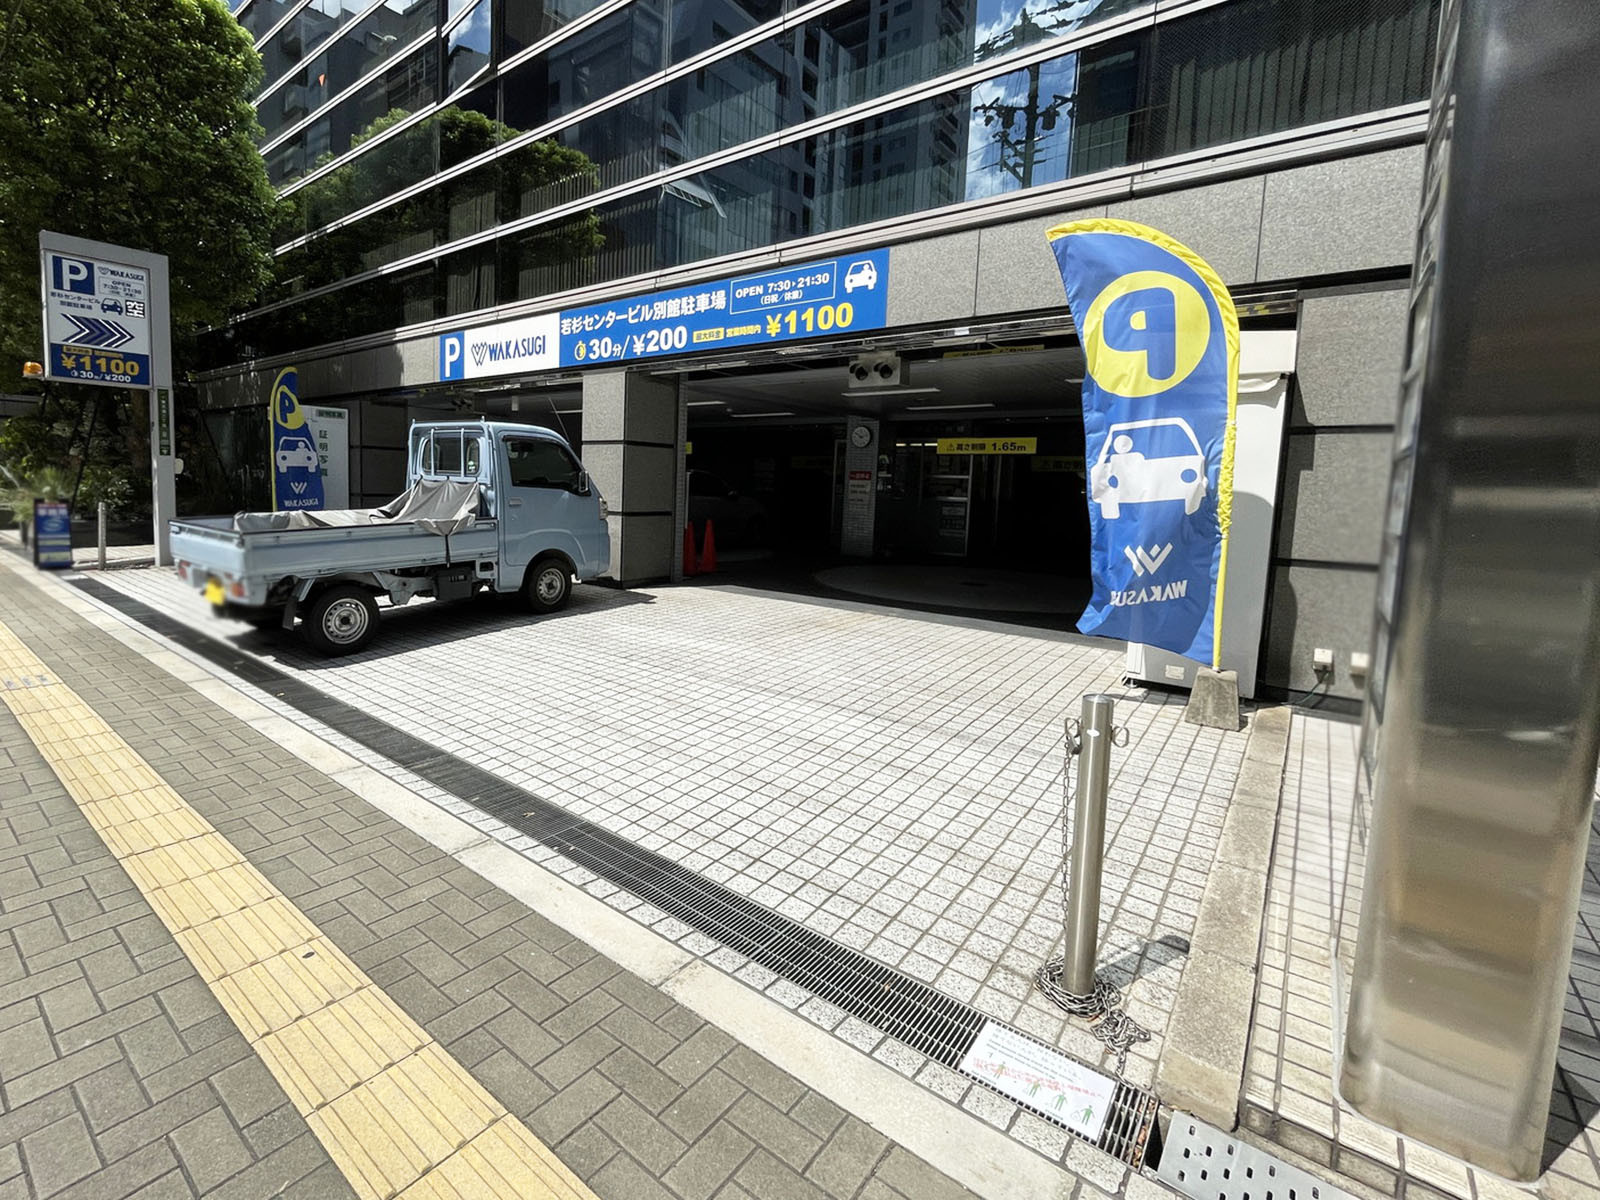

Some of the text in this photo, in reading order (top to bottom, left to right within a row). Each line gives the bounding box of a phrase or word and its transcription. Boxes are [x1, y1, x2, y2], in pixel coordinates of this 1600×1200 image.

[61, 258, 88, 290] P
[735, 272, 830, 299] OPEN 7:30 21:30
[560, 290, 726, 336] 若杉センタービル別館駐車場
[766, 303, 854, 337] ¥1100
[445, 337, 461, 378] P
[488, 335, 547, 361] WAKASUGI
[61, 353, 140, 376] ¥1100
[991, 441, 1027, 452] 1.65m
